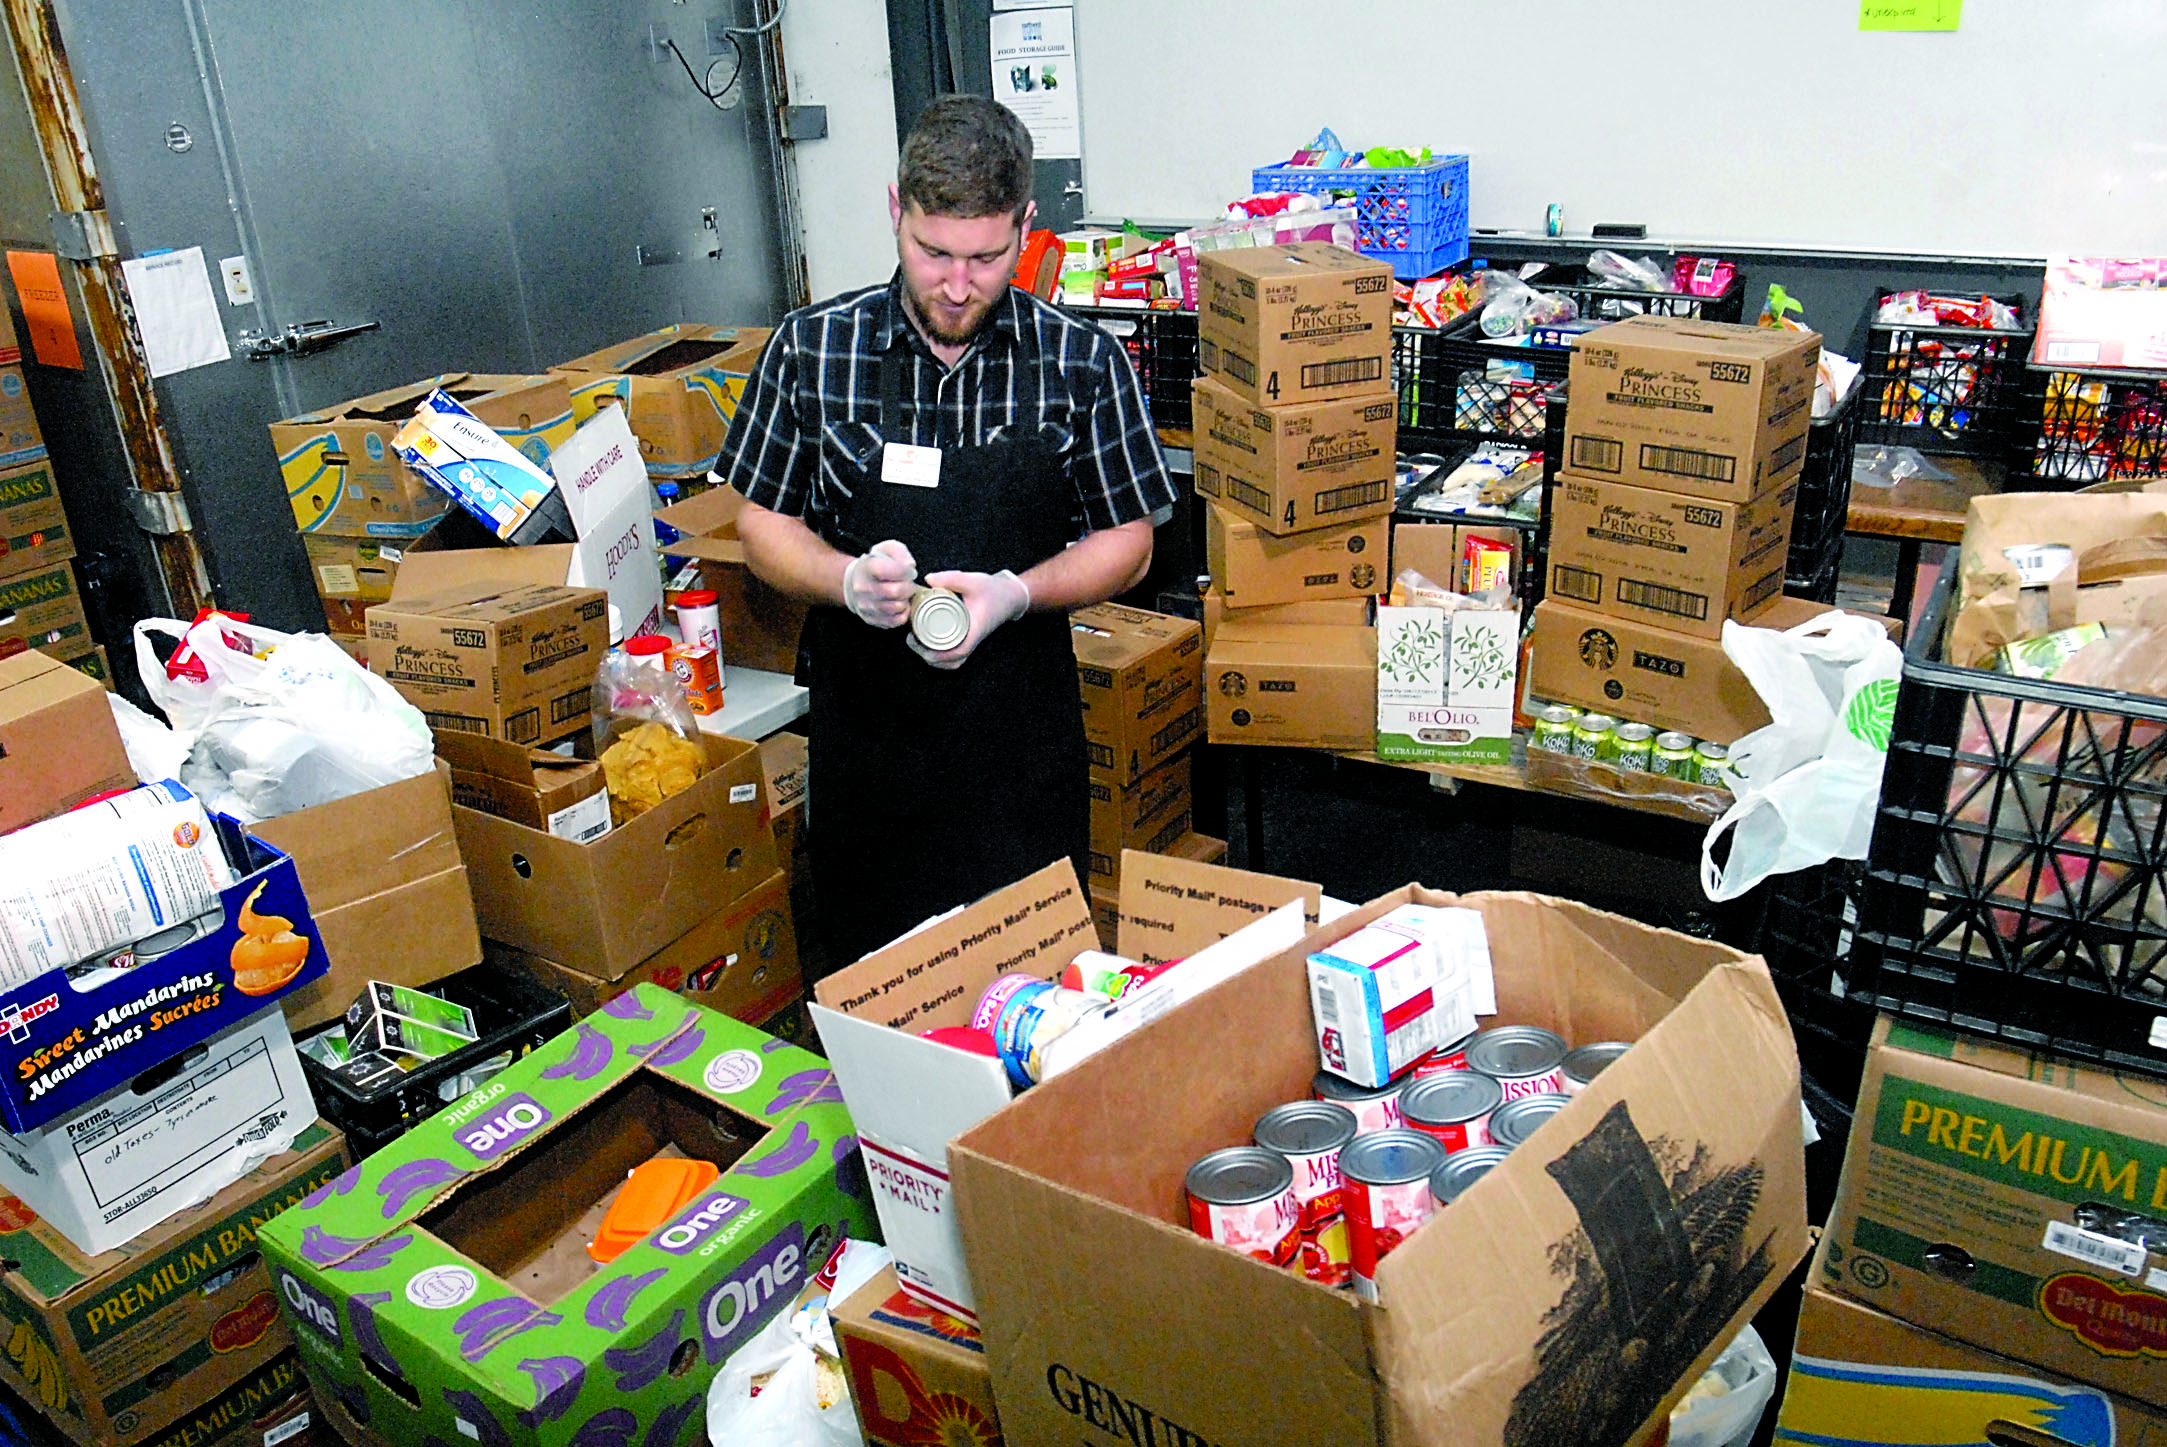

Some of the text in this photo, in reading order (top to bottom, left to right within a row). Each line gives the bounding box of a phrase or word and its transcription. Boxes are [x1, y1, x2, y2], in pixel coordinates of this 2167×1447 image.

[997, 44, 1065, 56] FOOD STORAGE GUIDE
[1357, 276, 1385, 293] 55672
[1291, 311, 1361, 330] PRINCESS
[1266, 371, 1280, 399] 4
[1712, 364, 1748, 382] 55672
[1619, 377, 1702, 402] PRINCESS
[1364, 403, 1391, 420] 55672
[424, 435, 437, 449] 30
[453, 420, 489, 445] Ensure
[1307, 439, 1370, 460] PRINCESS
[575, 466, 598, 494] HANDLE
[607, 445, 623, 466] CARE
[1284, 500, 1296, 527] 4
[1686, 507, 1721, 527] 55672
[1600, 514, 1676, 542] PRINCESS
[605, 522, 640, 580] HOODY'S
[455, 629, 485, 647] 55672
[394, 654, 463, 677] PRINCESS
[1639, 655, 1681, 675] TAZO
[1384, 746, 1410, 755] EXTRA
[1411, 748, 1437, 757] LIGHT
[1462, 750, 1485, 759] OLIVE
[1486, 751, 1500, 760] OIL
[181, 821, 197, 846] GOLD
[1145, 879, 1184, 899] Priority
[1218, 896, 1265, 912] postage
[1130, 915, 1174, 932] required
[840, 986, 880, 1012] Thank
[881, 974, 904, 995] you
[906, 962, 924, 979] for
[927, 947, 959, 969] using
[960, 922, 1002, 951] Priority
[1034, 887, 1072, 912] Service
[995, 945, 1038, 974] Priority
[920, 984, 964, 1013] Service
[0, 995, 58, 1035] DANDY
[20, 971, 214, 1079] Sweet Mandarins
[29, 986, 221, 1101] Mandarines Sucrées
[1503, 1071, 1561, 1101] ISSION
[165, 1096, 193, 1114] CONTENTS
[442, 1083, 505, 1127] organic
[66, 1107, 111, 1138] Perma
[264, 1114, 280, 1135] FOLD
[465, 1102, 543, 1152] One
[84, 1134, 97, 1144] BOX
[104, 1143, 121, 1164] Old
[123, 1131, 154, 1151] Taxes
[1901, 1099, 2139, 1201] PREMIUM
[869, 1158, 942, 1201] PRIORITY
[890, 1185, 929, 1212] MAIL
[659, 1197, 737, 1248] One
[699, 1207, 763, 1256] organic
[86, 1242, 218, 1334] PREMIUM
[706, 1244, 800, 1339] One
[282, 1273, 338, 1336] One
